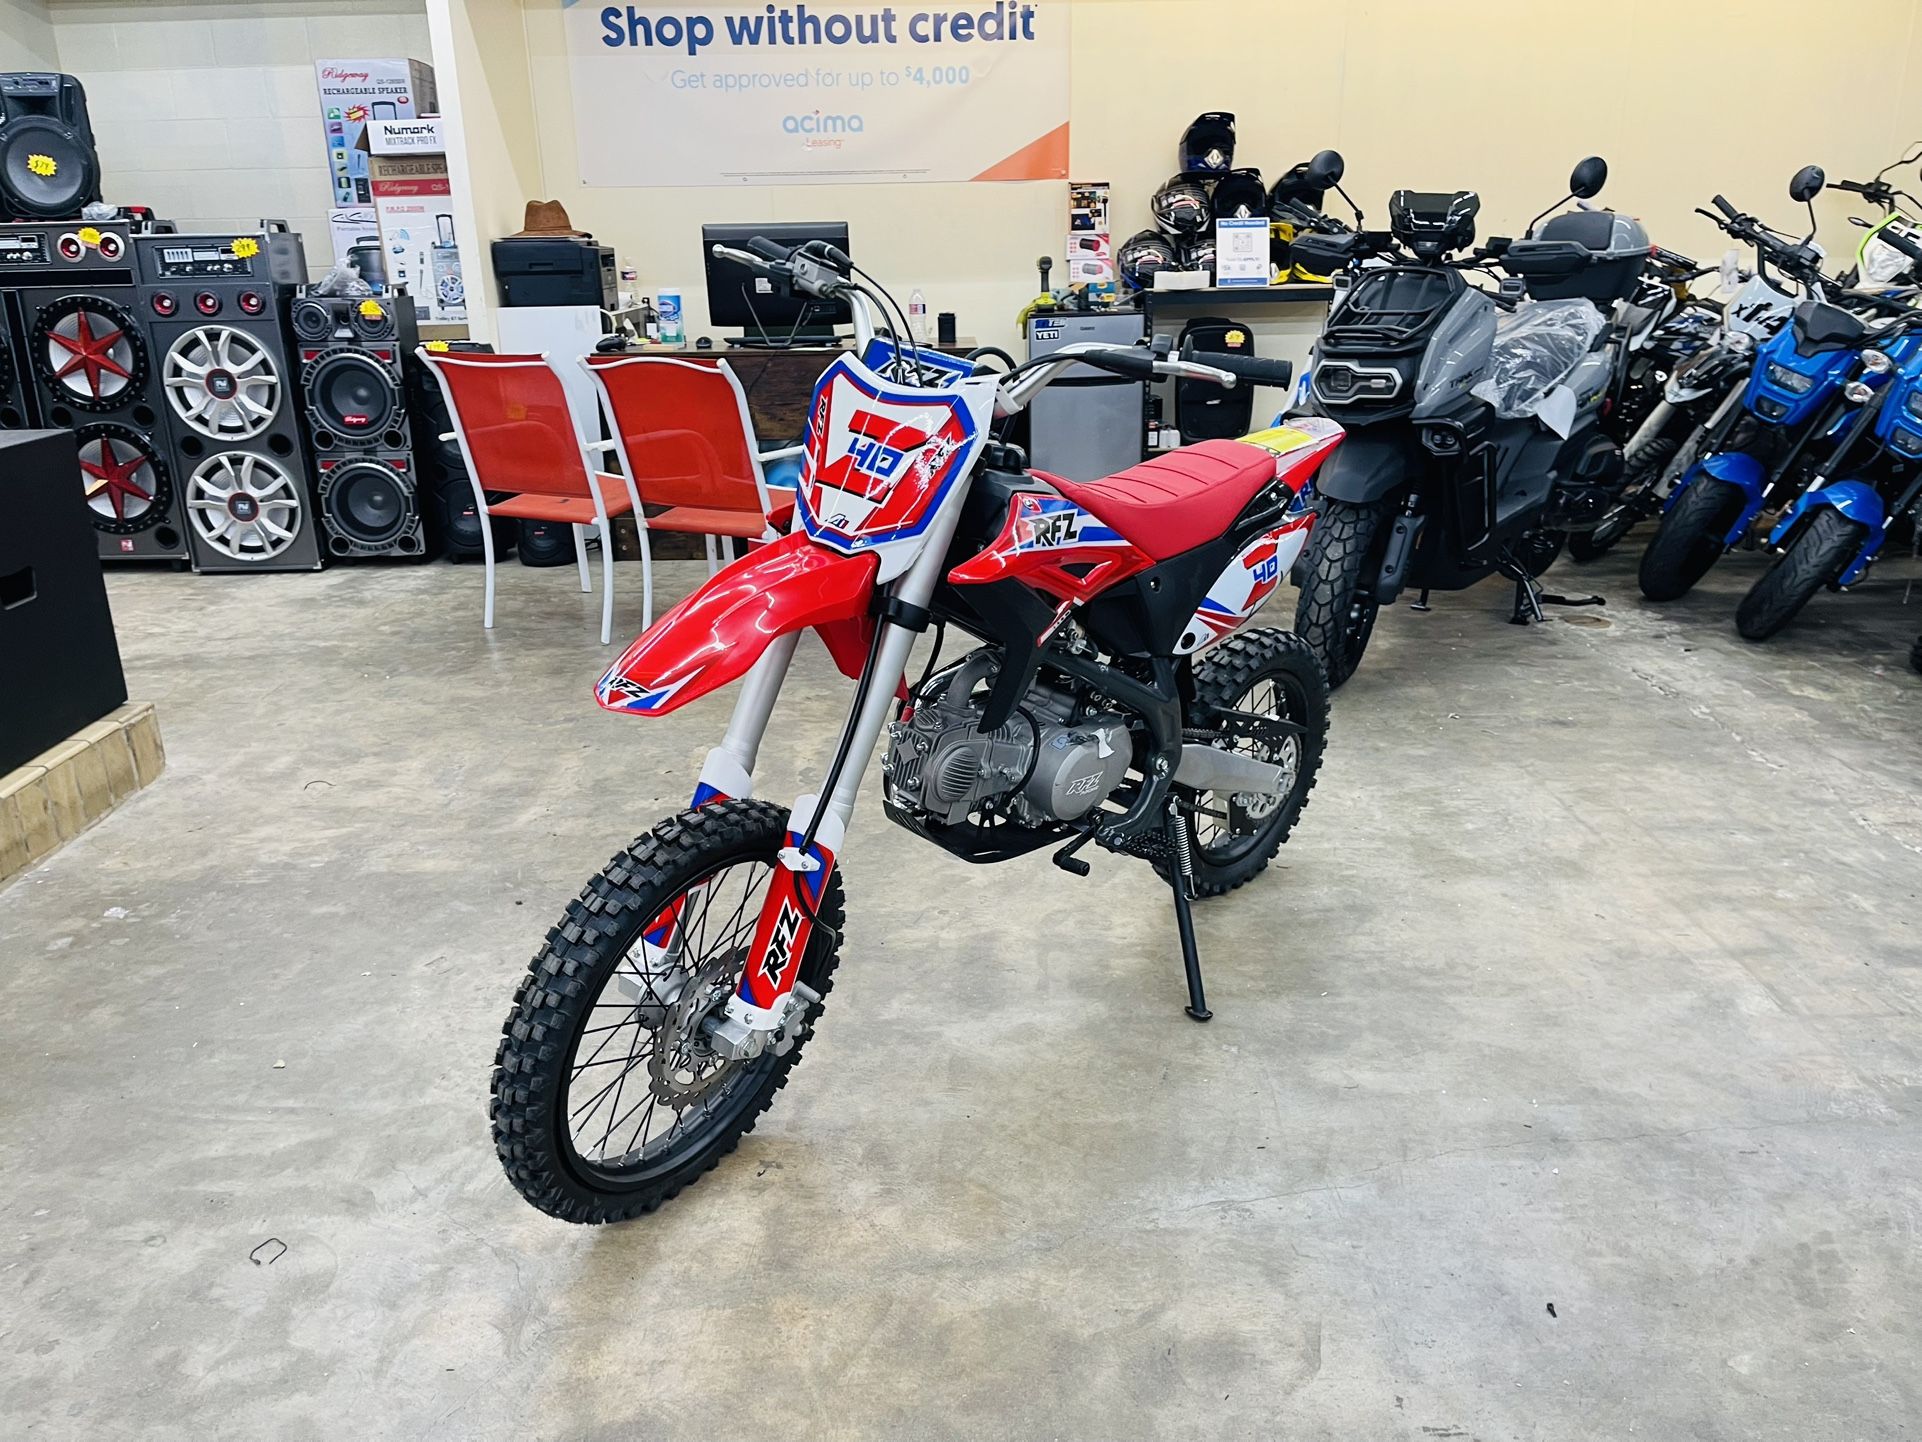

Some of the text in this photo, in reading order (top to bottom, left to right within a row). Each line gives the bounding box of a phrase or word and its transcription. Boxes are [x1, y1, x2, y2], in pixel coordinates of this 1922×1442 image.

[601, 0, 1036, 56] Shop without credit
[323, 86, 408, 96] RECHARGEABLE SPEAKER
[671, 65, 970, 92] Get approved for up to $4,000
[384, 124, 435, 136] Numark
[782, 110, 864, 134] acima
[1036, 331, 1058, 340] YETI
[816, 397, 828, 436] RFZ
[1030, 512, 1078, 547] RFZ
[1253, 554, 1279, 582] 40
[760, 899, 803, 987] RFZ
